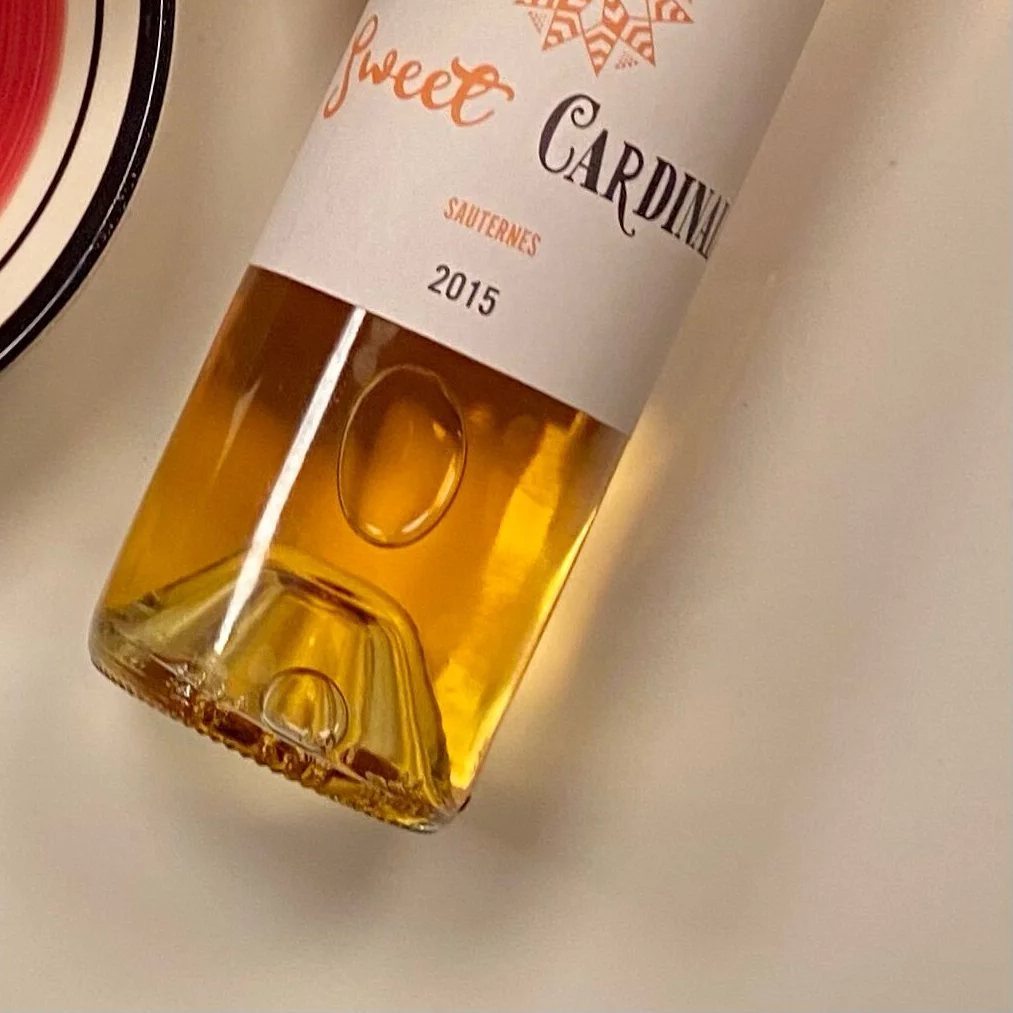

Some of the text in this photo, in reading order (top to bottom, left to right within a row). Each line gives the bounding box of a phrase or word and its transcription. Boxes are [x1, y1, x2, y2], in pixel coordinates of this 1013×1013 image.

[324, 14, 515, 126] Sweet
[443, 197, 541, 257] SAUTERNES
[428, 264, 500, 316] 2015
